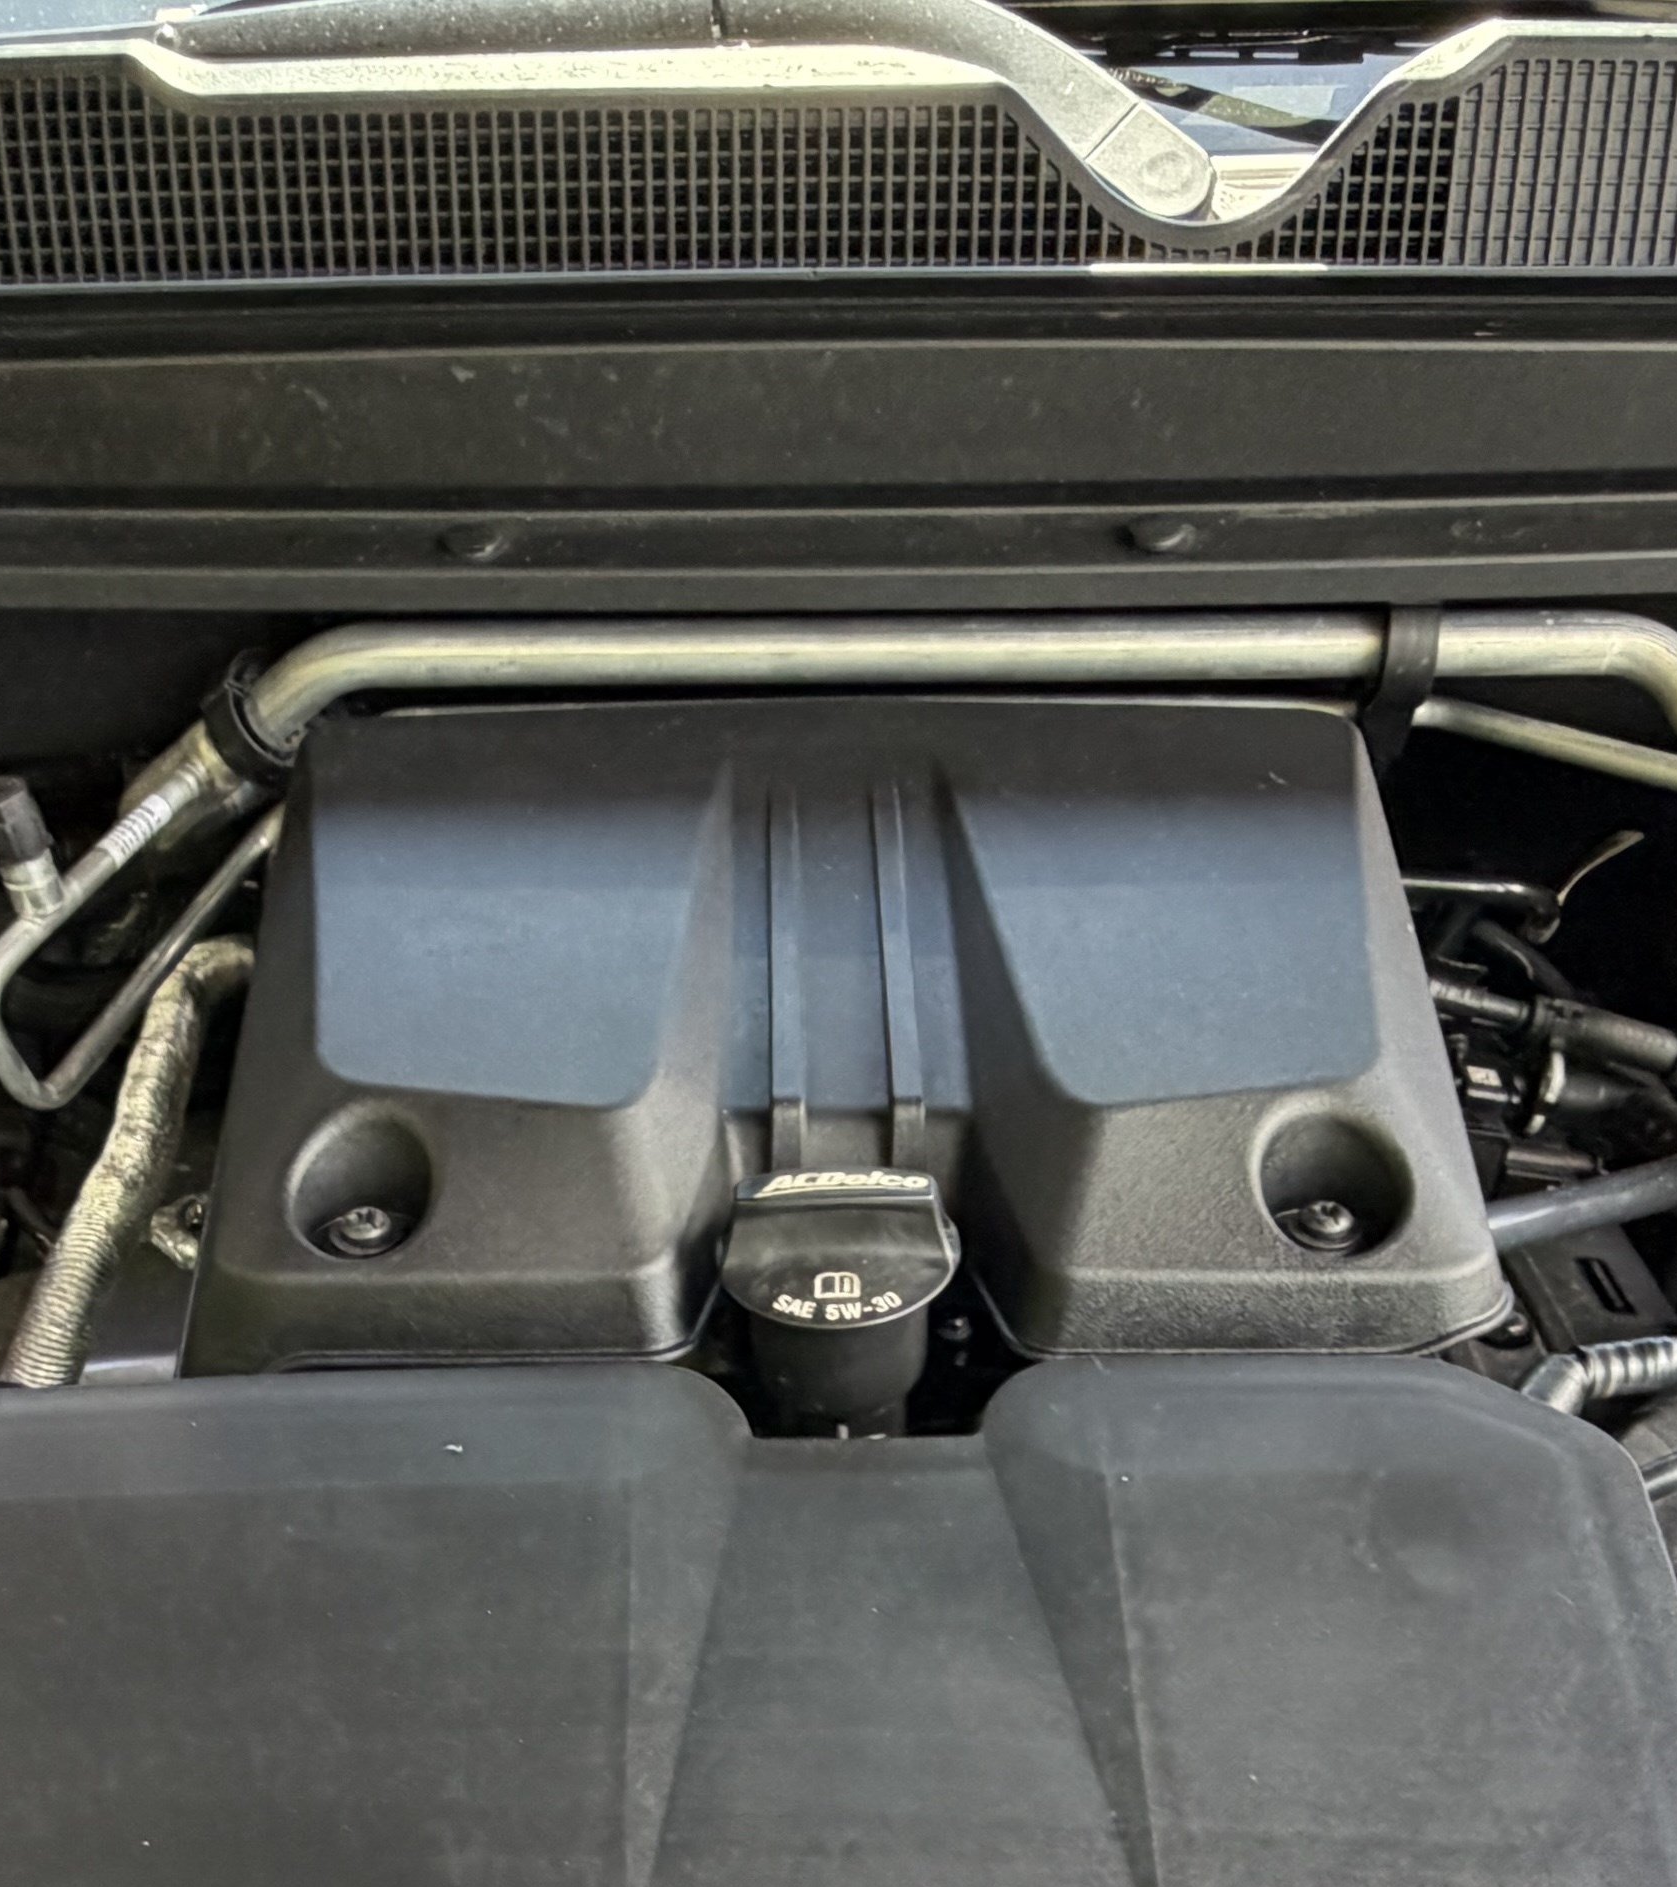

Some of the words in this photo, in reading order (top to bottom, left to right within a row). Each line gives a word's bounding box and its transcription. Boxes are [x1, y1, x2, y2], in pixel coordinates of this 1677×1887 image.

[762, 1170, 931, 1193] ACDelco
[772, 1294, 817, 1320] SAE
[825, 1291, 903, 1321] 5W-30
